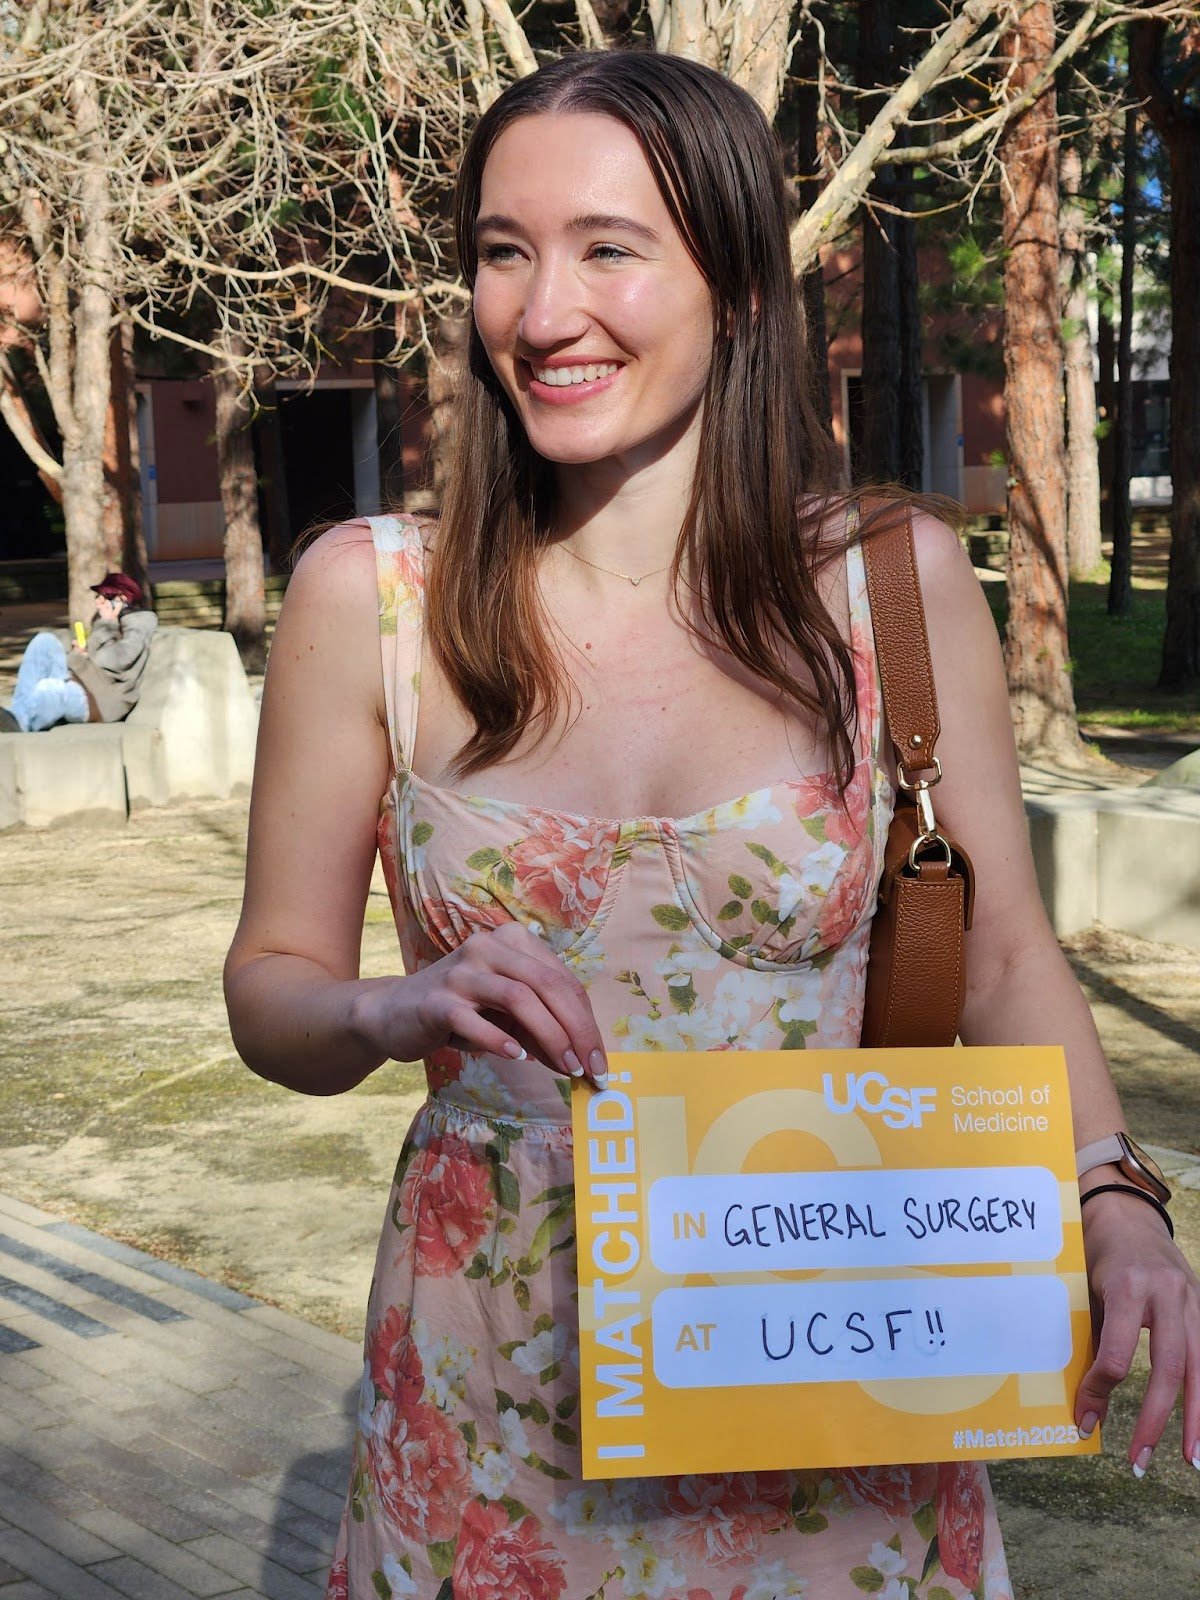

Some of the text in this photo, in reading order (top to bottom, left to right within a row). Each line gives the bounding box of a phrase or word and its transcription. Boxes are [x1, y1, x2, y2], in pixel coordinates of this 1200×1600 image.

[822, 1071, 937, 1129] UCSF
[952, 1085, 1051, 1106] School of
[953, 1112, 1049, 1133] Medicine
[672, 1211, 707, 1240] IN
[724, 1196, 1036, 1247] GENERAL SURGERY
[676, 1323, 717, 1352] AT
[953, 1424, 1080, 1449] #Match2025
[598, 1444, 645, 1459] I
